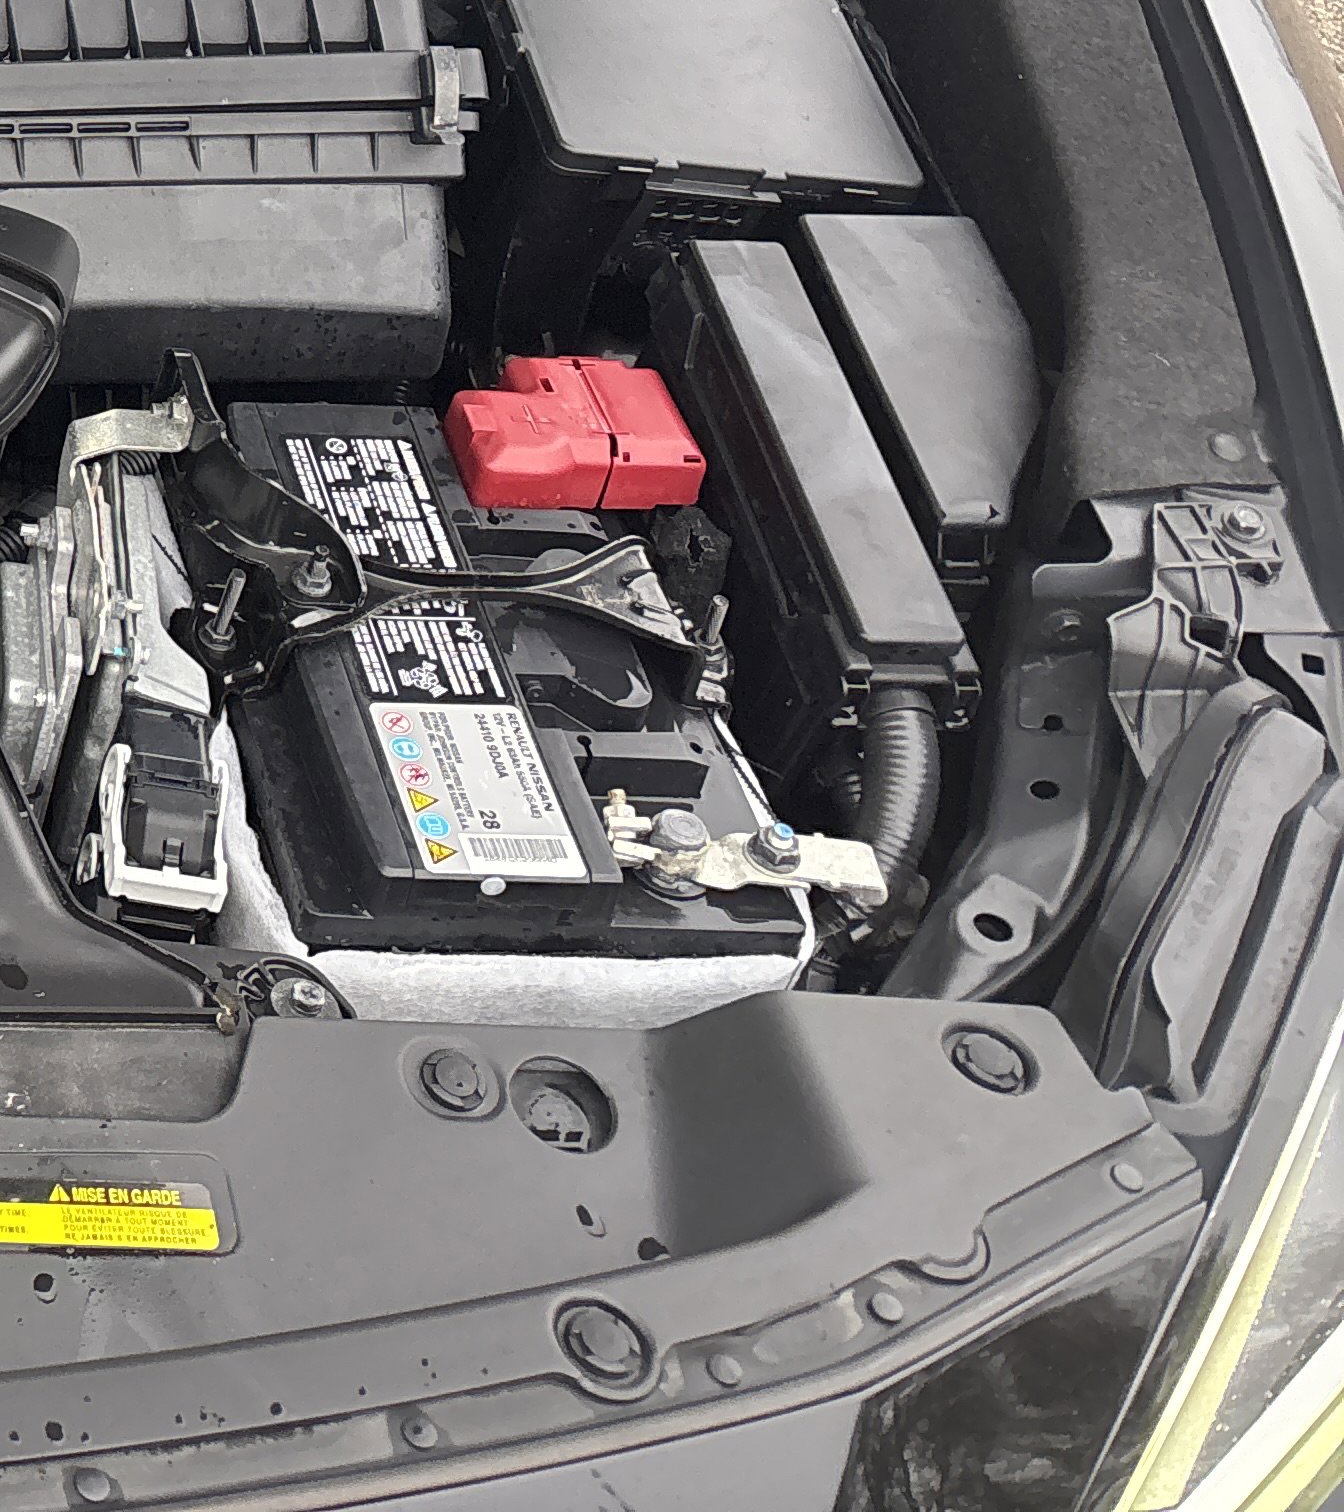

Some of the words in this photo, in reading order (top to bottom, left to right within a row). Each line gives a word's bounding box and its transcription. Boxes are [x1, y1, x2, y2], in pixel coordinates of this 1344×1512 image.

[473, 712, 494, 742] 24410
[505, 712, 533, 758] RENAULT
[525, 762, 555, 811] NISSAN
[477, 809, 501, 830] 28
[72, 1187, 107, 1203] MISE
[108, 1188, 129, 1204] EN
[131, 1189, 182, 1205] GARDE
[75, 1208, 135, 1217] VENTILATEUR
[140, 1210, 172, 1218] RISQUE
[176, 1210, 187, 1218] DE
[125, 1217, 147, 1225] TOUT
[151, 1218, 188, 1226] MOMENT
[64, 1224, 88, 1232] POUR
[127, 1225, 157, 1234] TOUTE
